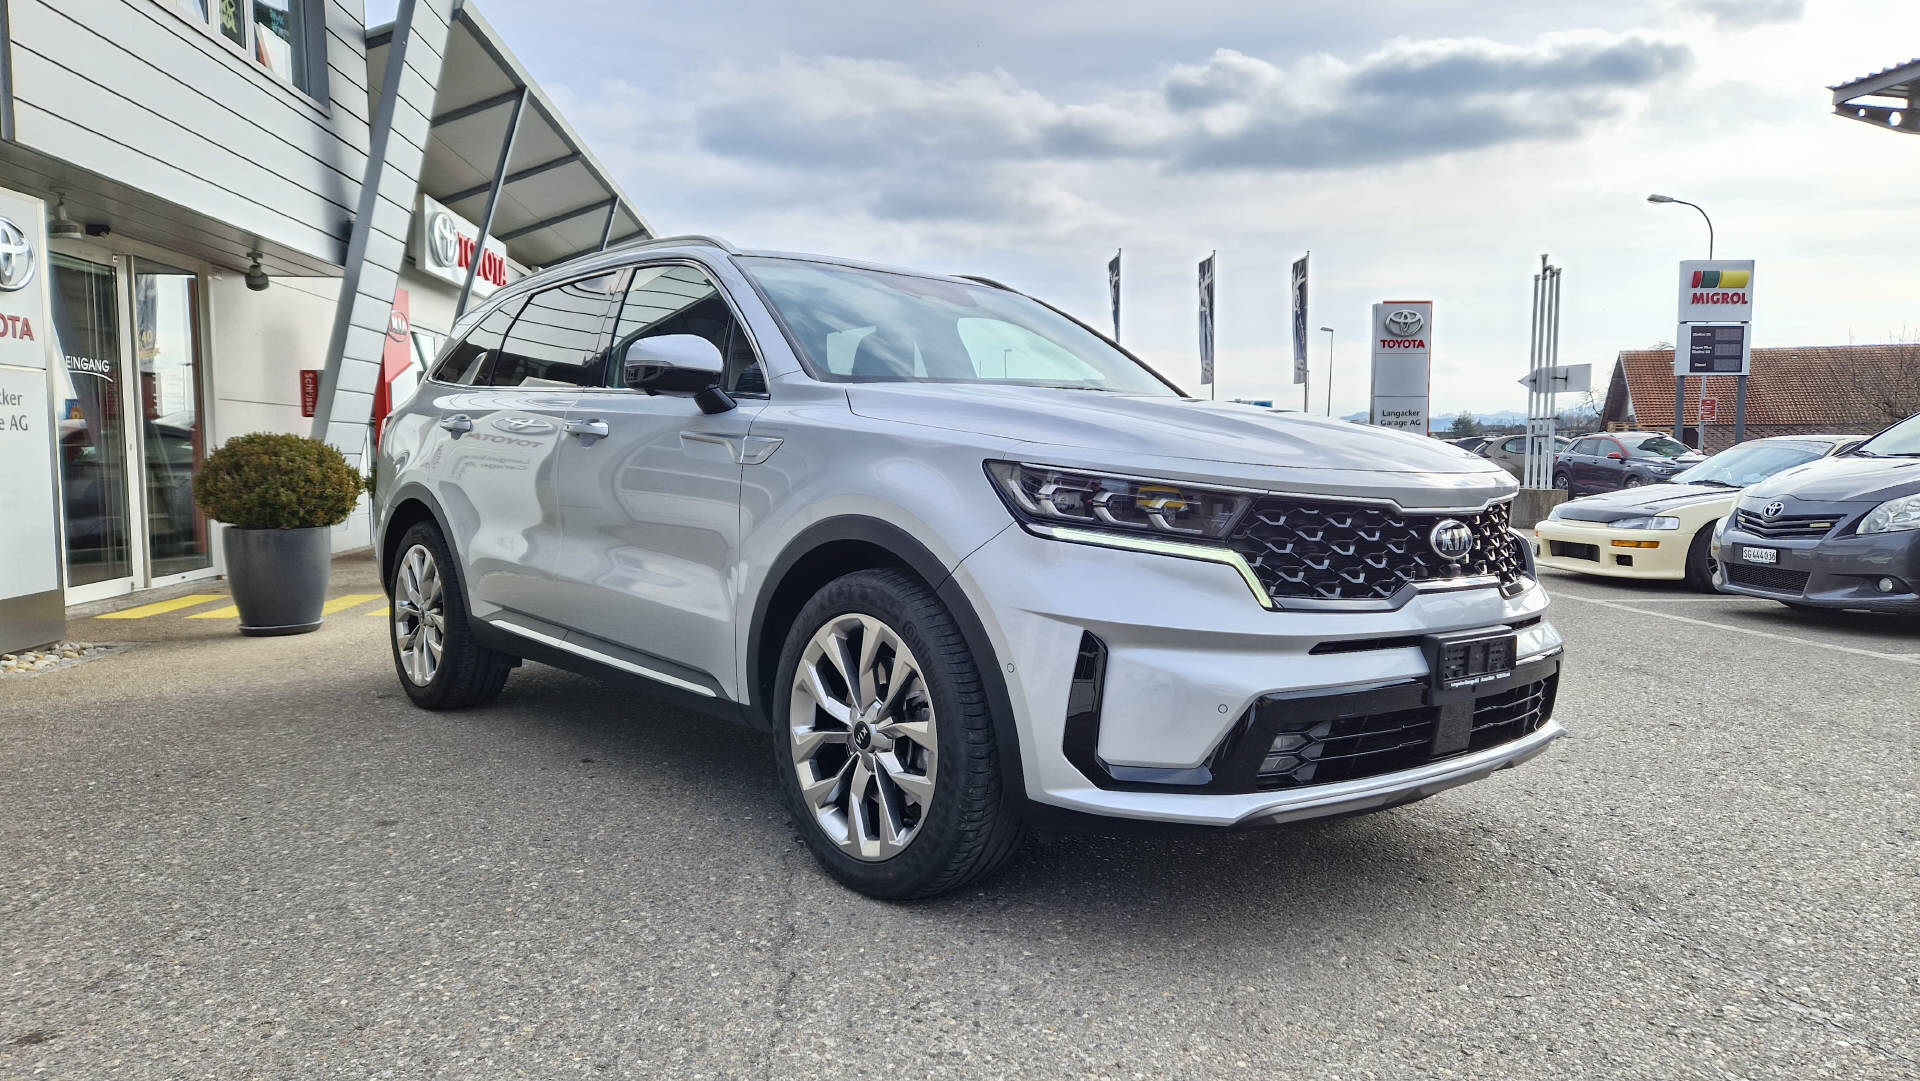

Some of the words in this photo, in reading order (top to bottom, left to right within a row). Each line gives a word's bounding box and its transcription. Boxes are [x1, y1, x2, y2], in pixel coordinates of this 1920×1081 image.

[457, 231, 507, 287] TOOTA
[1691, 292, 1748, 305] MIGROL
[1380, 339, 1425, 349] TOYOTA
[65, 355, 110, 373] EINGANG
[1382, 409, 1420, 419] Langacker
[9, 414, 29, 431] AG
[1380, 419, 1408, 428] Garage
[1409, 418, 1421, 427] AG
[1440, 527, 1470, 551] KIA
